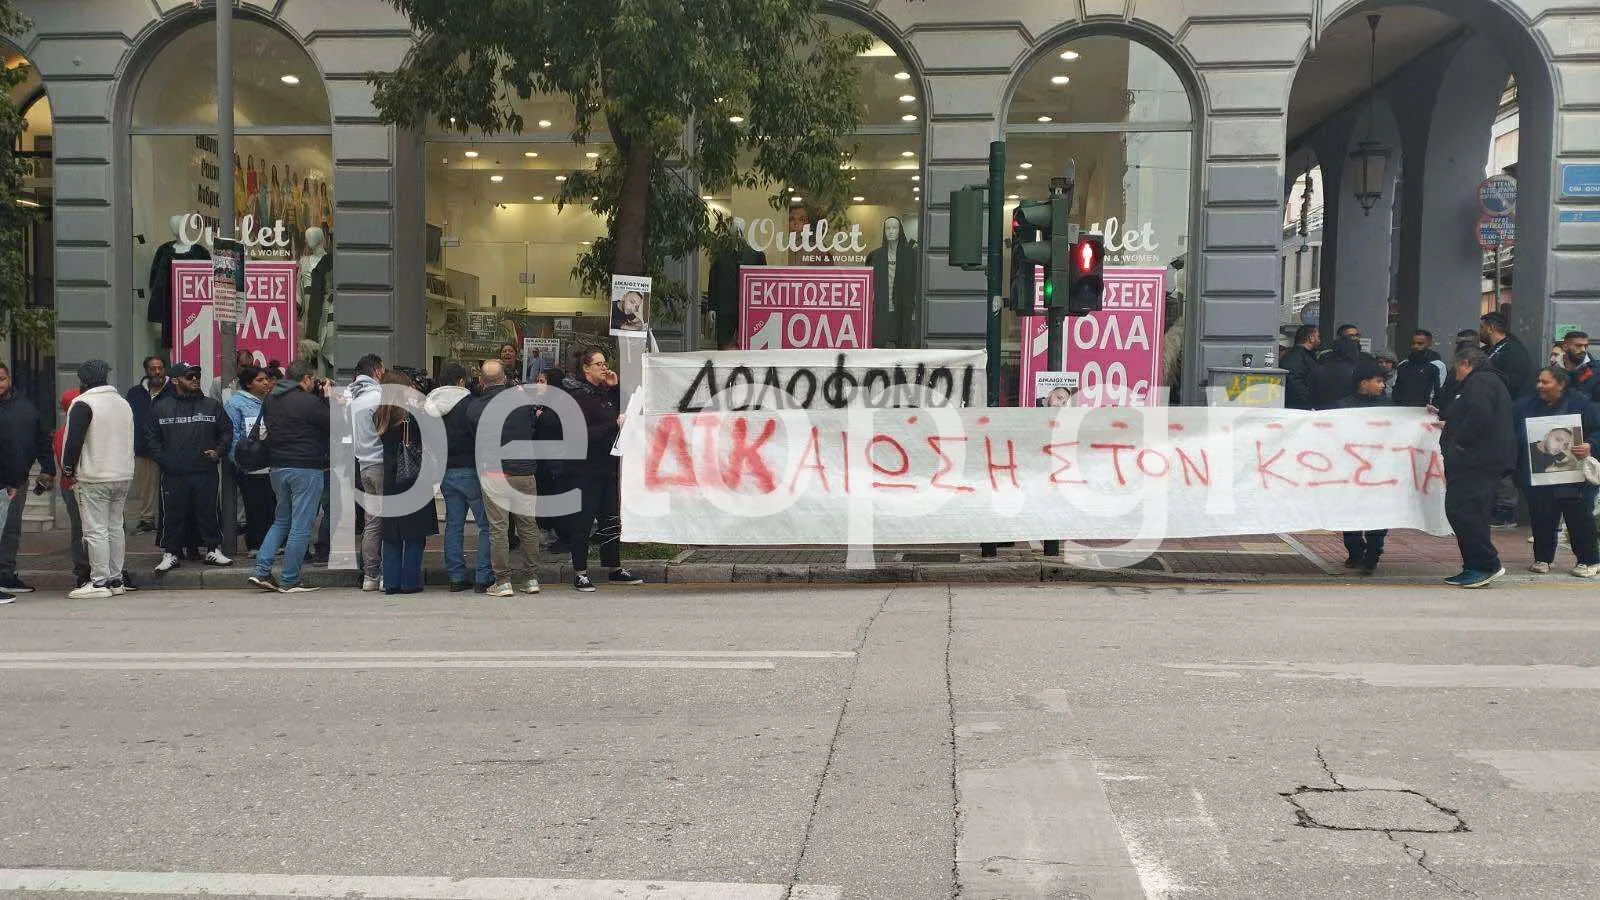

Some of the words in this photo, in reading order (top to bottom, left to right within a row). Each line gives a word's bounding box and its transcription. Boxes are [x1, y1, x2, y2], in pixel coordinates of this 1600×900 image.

[259, 249, 291, 257] WOMEN
[748, 218, 867, 253] Outlet
[802, 254, 822, 263] MEN
[832, 254, 867, 263] WOMEN
[1122, 254, 1159, 262] WOMEN
[751, 282, 862, 307] ΕΚΠΤΩΣΕΙΣ
[787, 313, 860, 348] ΟΛΑ
[1074, 313, 1150, 351] ΟΛΑ
[678, 353, 974, 412] ΔΟΛΟΦΟΝΟΙ
[645, 411, 1020, 494] ΔΙΚΑΙΩΣΗ
[1042, 441, 1209, 487] ΣΤΟΝ
